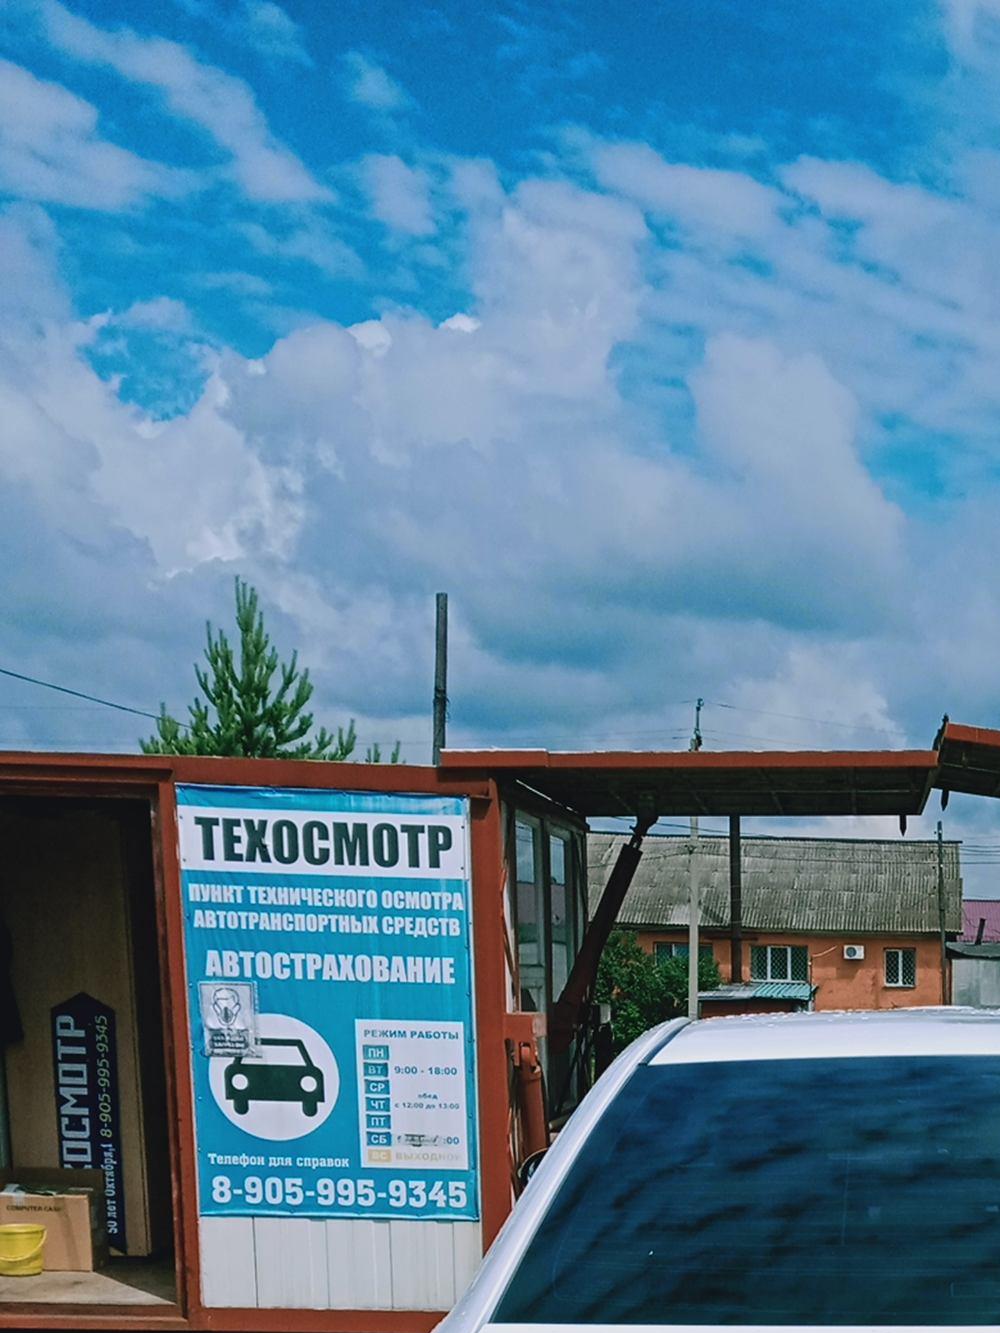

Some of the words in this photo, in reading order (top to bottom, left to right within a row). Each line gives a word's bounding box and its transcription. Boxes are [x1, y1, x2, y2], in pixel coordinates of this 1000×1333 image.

[194, 816, 453, 869] ТЕХОСМОТР
[188, 883, 243, 904] ПУНКТ
[247, 886, 379, 909] ТЕХНИЧЕСКОГО
[381, 889, 464, 911] ОСМОТРА
[193, 909, 379, 935] АВТОТРАНСПОРТНЫХ
[381, 915, 461, 938] СРЕДСТВ
[205, 950, 456, 985] АВТОСТРАХОВАНИЕ
[363, 1028, 408, 1040] РЕЖИМ
[409, 1029, 459, 1040] РАБОТЫ
[367, 1048, 385, 1058] ПН
[368, 1065, 384, 1075] ВТ
[394, 1066, 418, 1076] 9:00
[427, 1066, 458, 1076] 18:00
[369, 1082, 385, 1092] СР
[370, 1100, 386, 1110] ЧТ
[371, 1117, 386, 1127] ПТ
[371, 1134, 387, 1144] СБ
[208, 1153, 265, 1167] Телефон
[269, 1156, 292, 1168] для
[296, 1156, 350, 1170] справок
[211, 1175, 468, 1208] 8-905-995-9345
